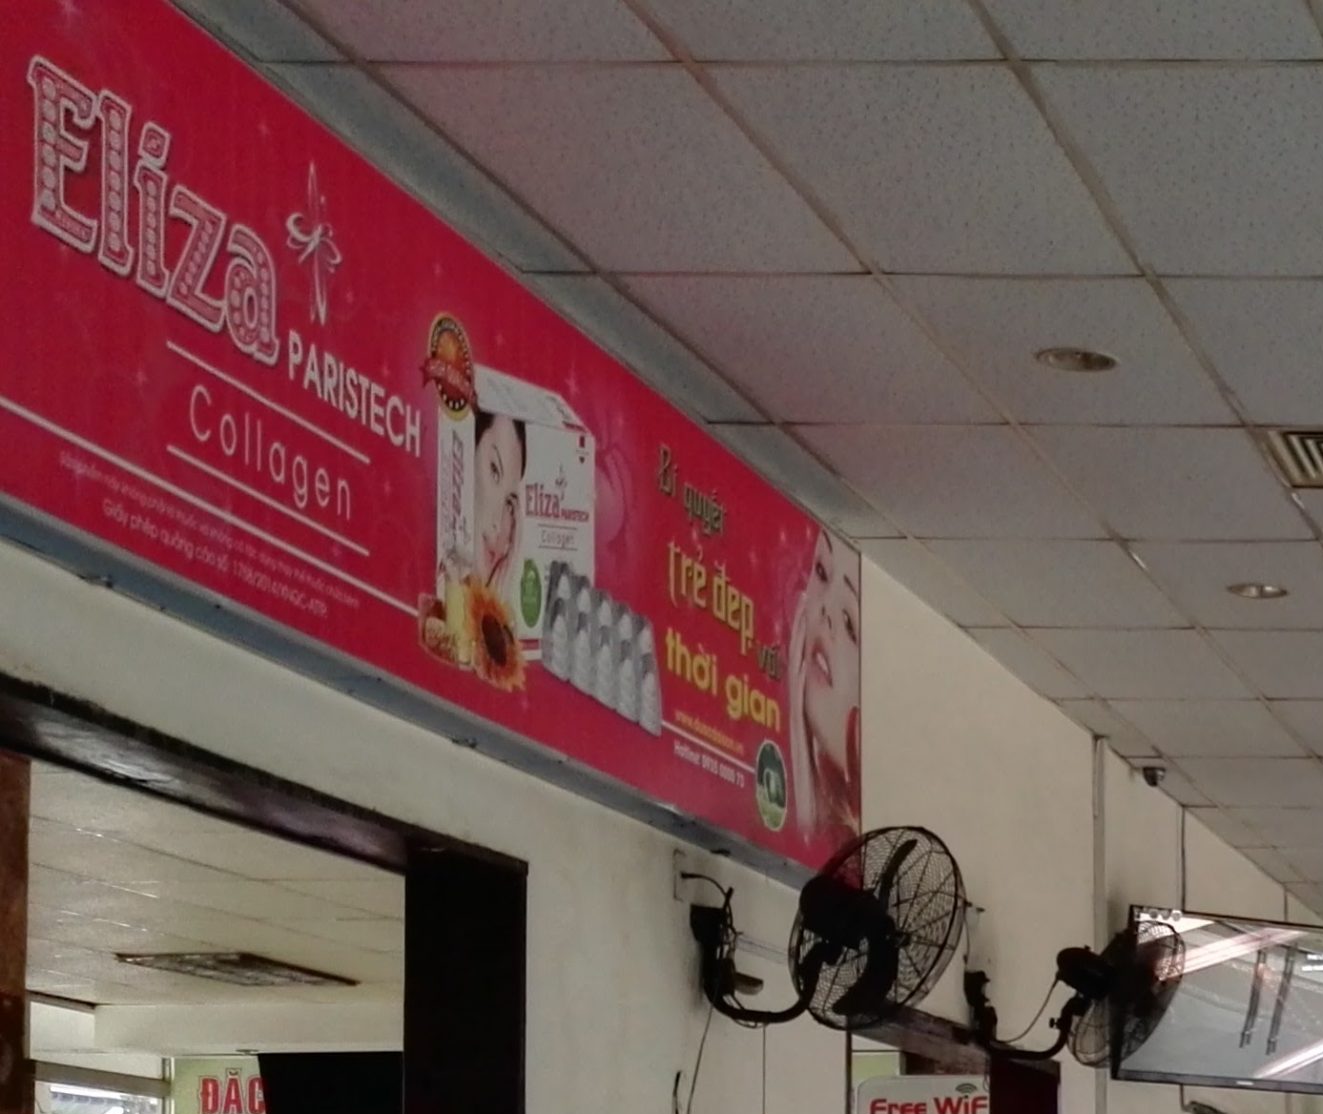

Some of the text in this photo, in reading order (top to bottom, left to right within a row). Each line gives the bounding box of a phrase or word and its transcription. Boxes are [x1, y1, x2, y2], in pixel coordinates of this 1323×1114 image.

[27, 55, 280, 365] Eliza
[288, 329, 421, 458] PARISTECH
[190, 385, 351, 520] Collagen
[526, 483, 560, 518] Eliza
[667, 540, 707, 608] trẻ
[665, 627, 781, 732] thời gian
